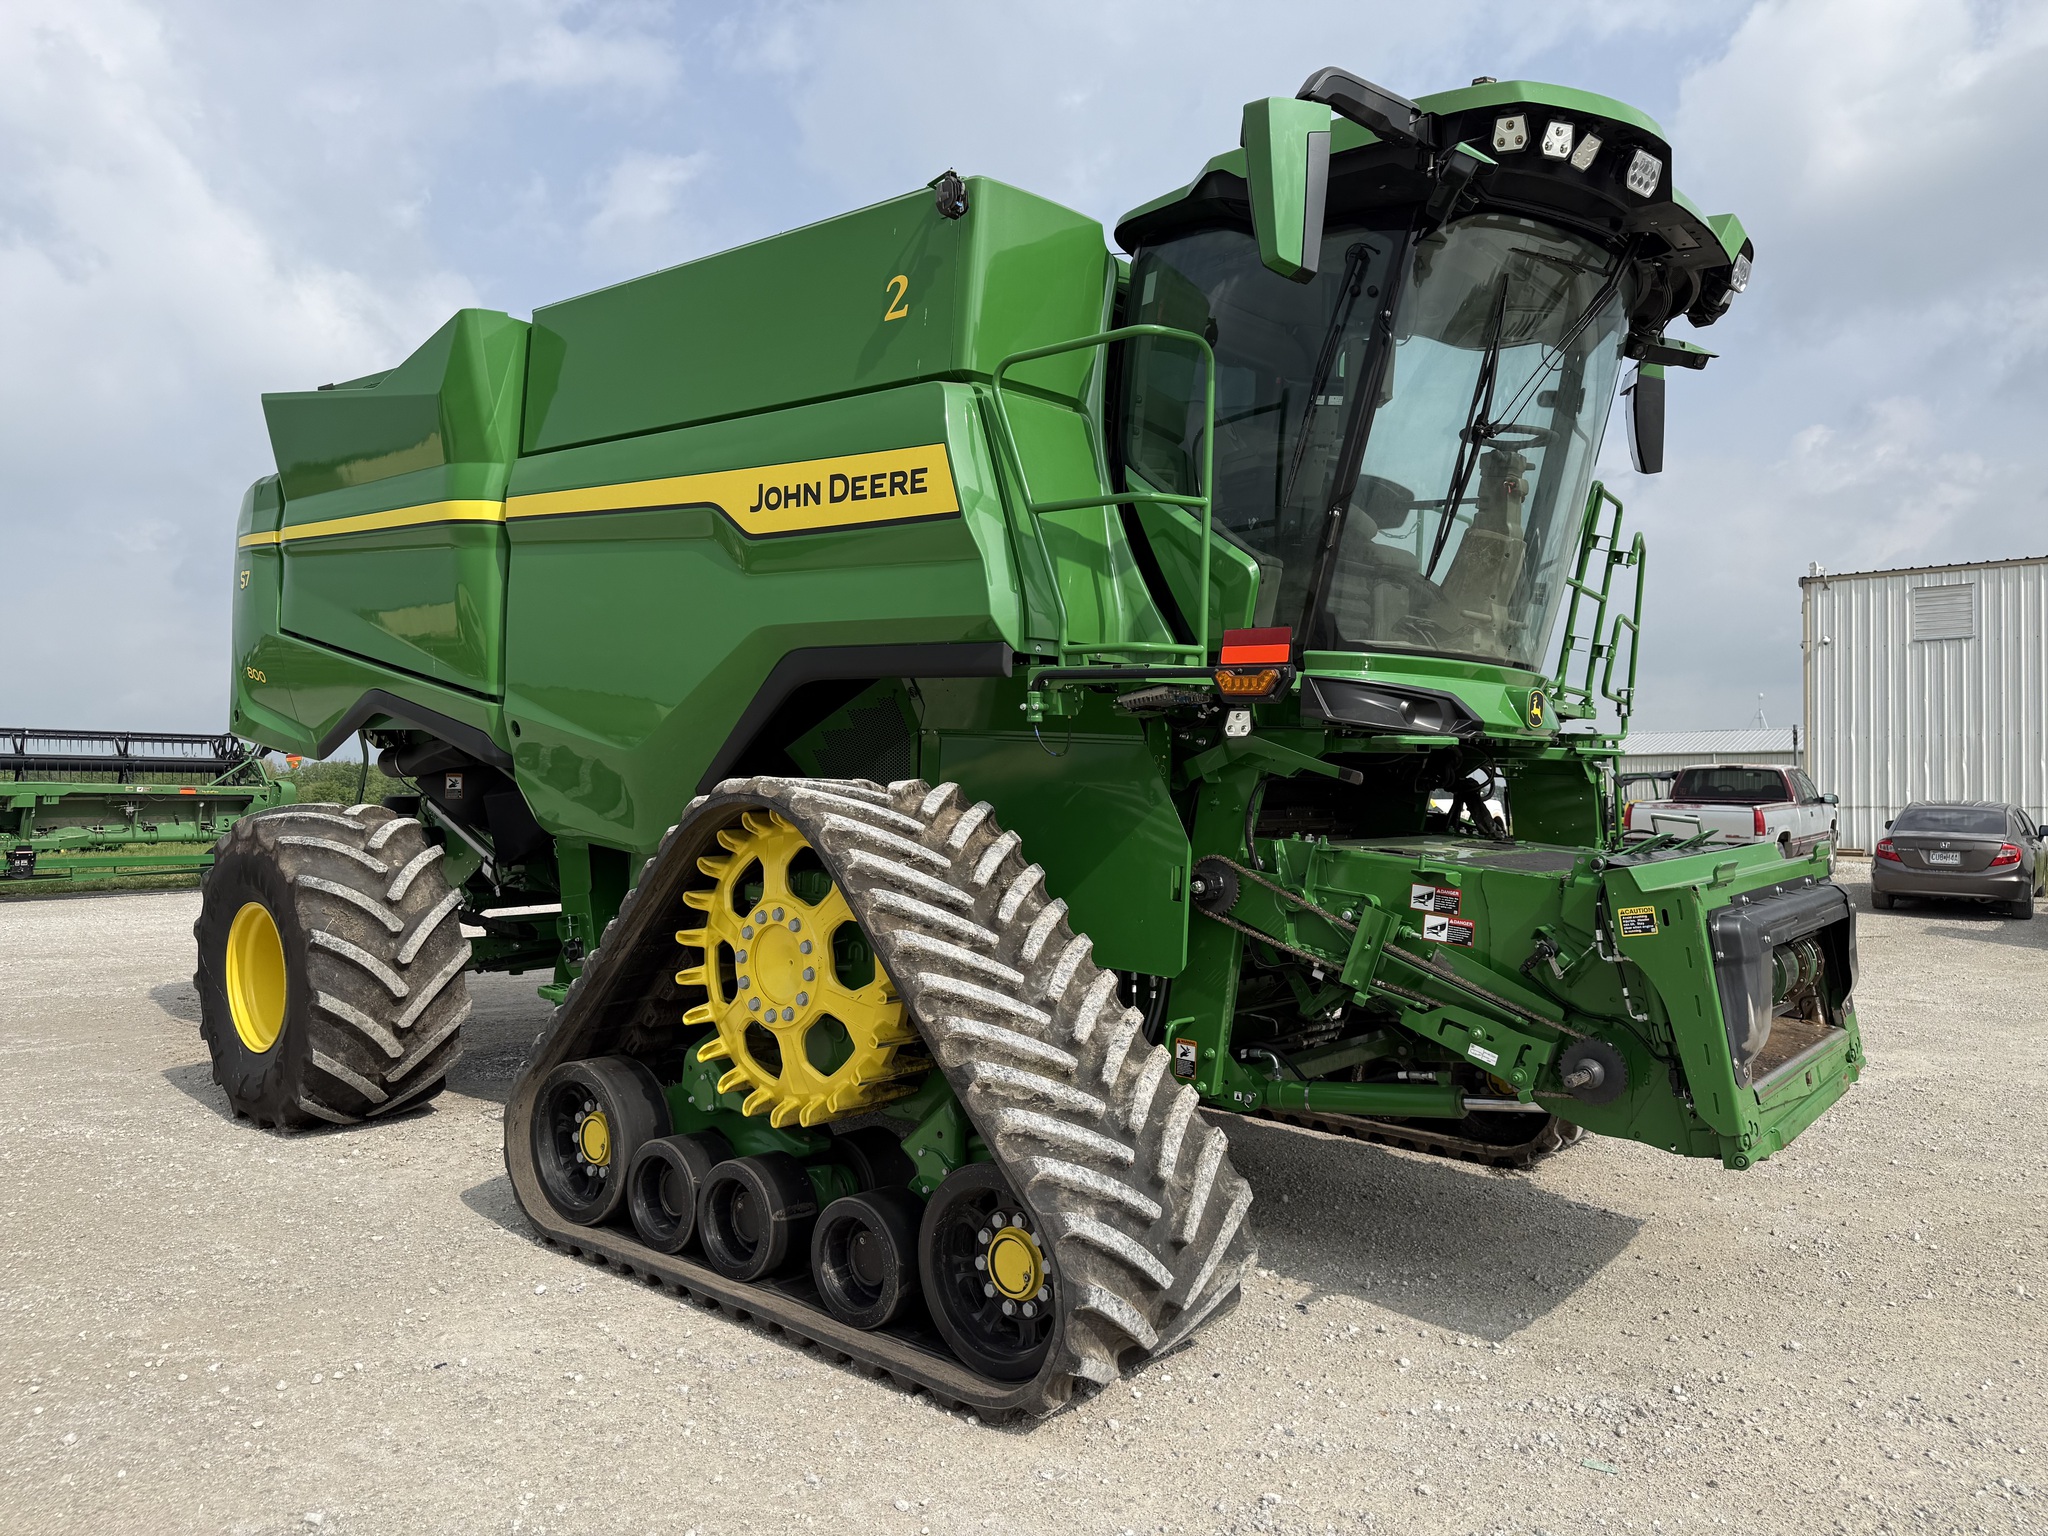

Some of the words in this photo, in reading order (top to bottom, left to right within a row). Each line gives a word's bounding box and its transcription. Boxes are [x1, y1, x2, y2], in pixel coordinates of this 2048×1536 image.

[884, 274, 909, 322] 2
[749, 481, 821, 513] JOHN
[829, 467, 928, 504] DEERE
[240, 570, 251, 589] S7
[246, 666, 267, 683] 800
[1454, 919, 1473, 927] DANGER
